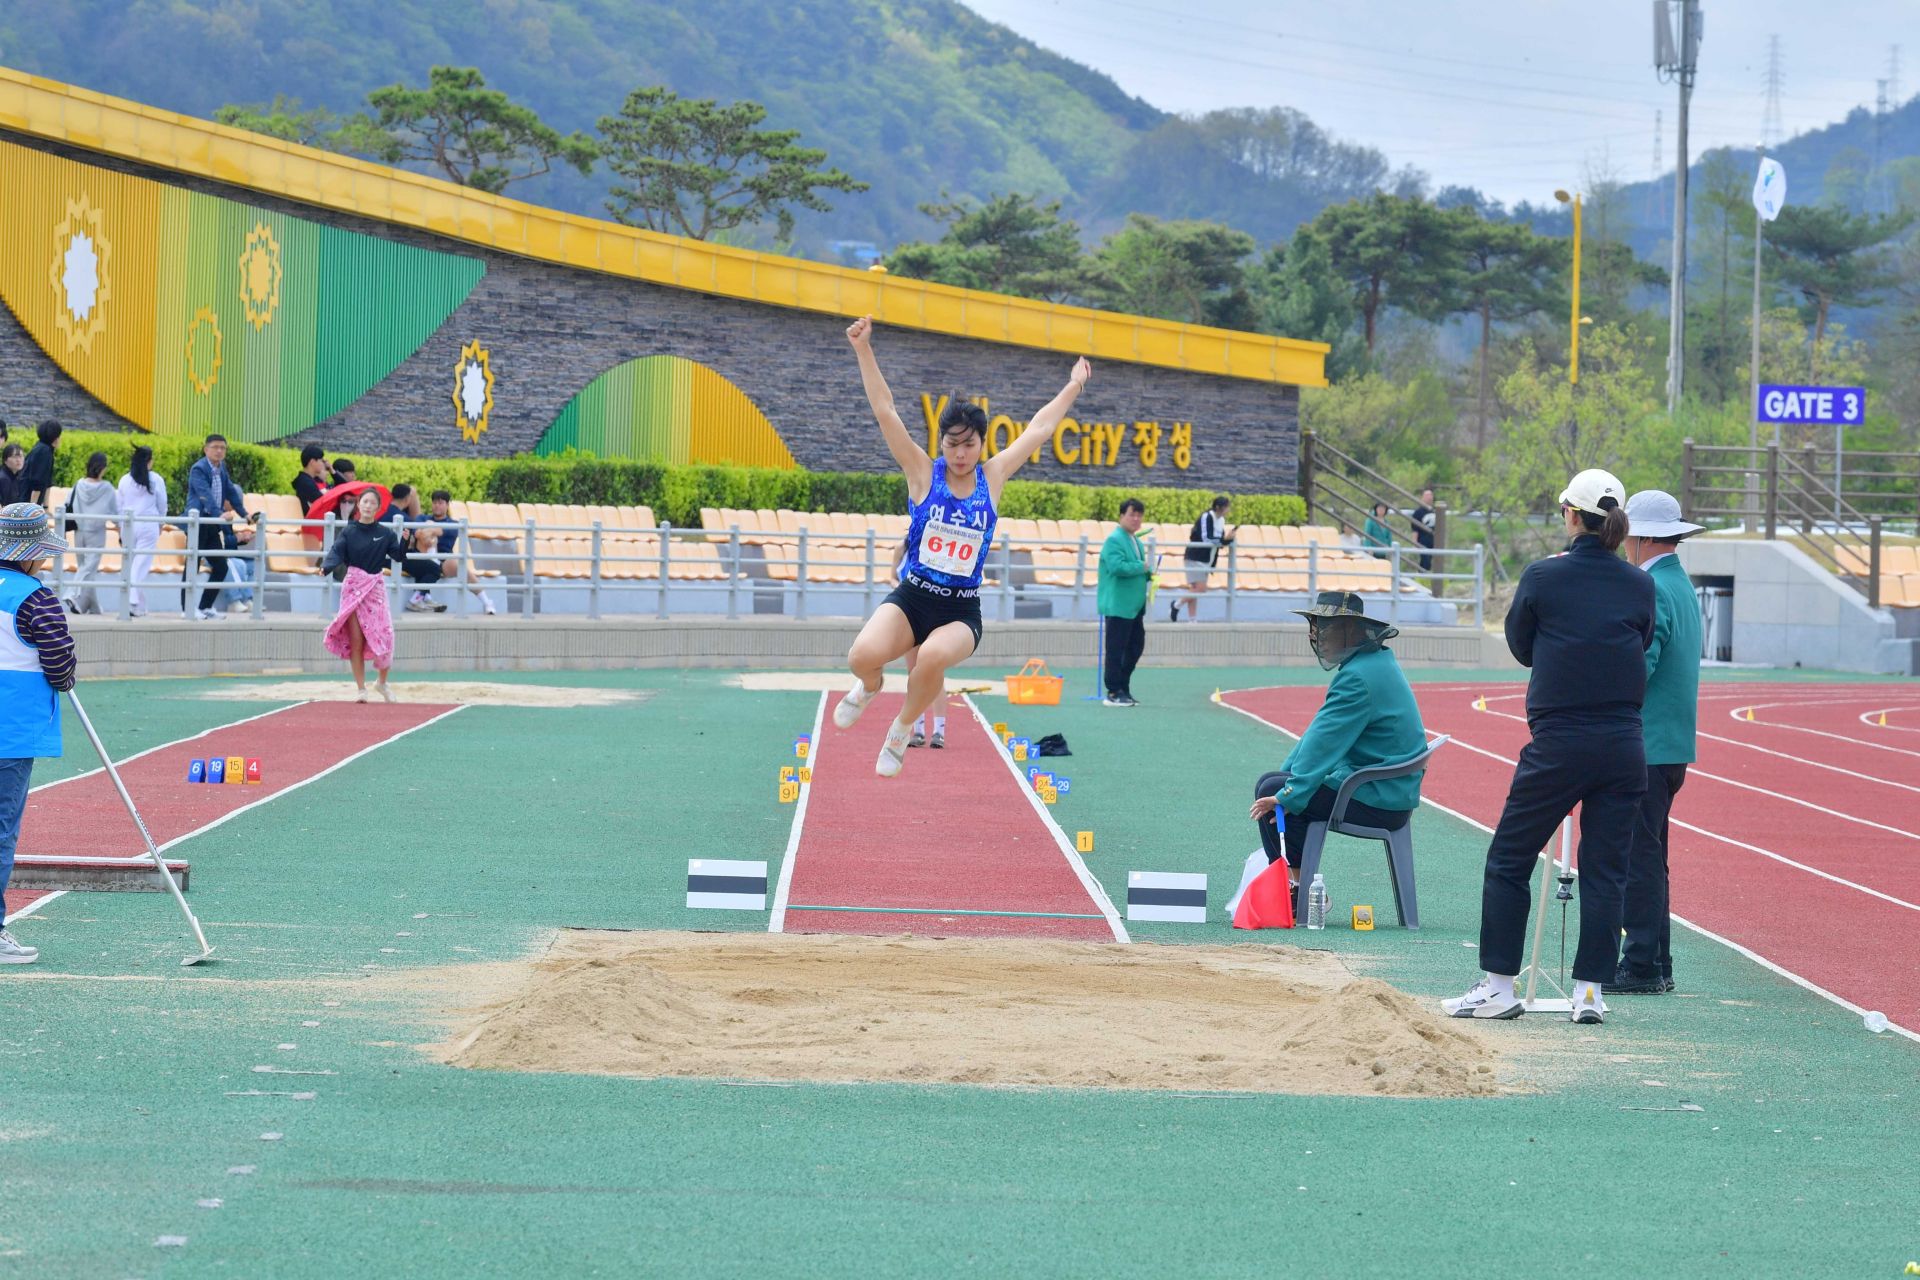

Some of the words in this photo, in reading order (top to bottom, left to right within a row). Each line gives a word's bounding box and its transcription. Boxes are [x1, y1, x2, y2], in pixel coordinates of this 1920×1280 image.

[1764, 390, 1833, 419] GATE
[1842, 393, 1859, 420] 3
[1053, 418, 1126, 466] City
[1132, 421, 1193, 470] 장성
[927, 536, 973, 561] 610
[920, 581, 952, 597] PRO
[1030, 747, 1038, 758] 7
[192, 763, 201, 774] 6
[211, 761, 221, 772] 19
[229, 760, 239, 771] 15
[249, 761, 257, 772] 4
[799, 770, 810, 781] 10
[1057, 780, 1070, 792] 29
[782, 787, 791, 799] 9
